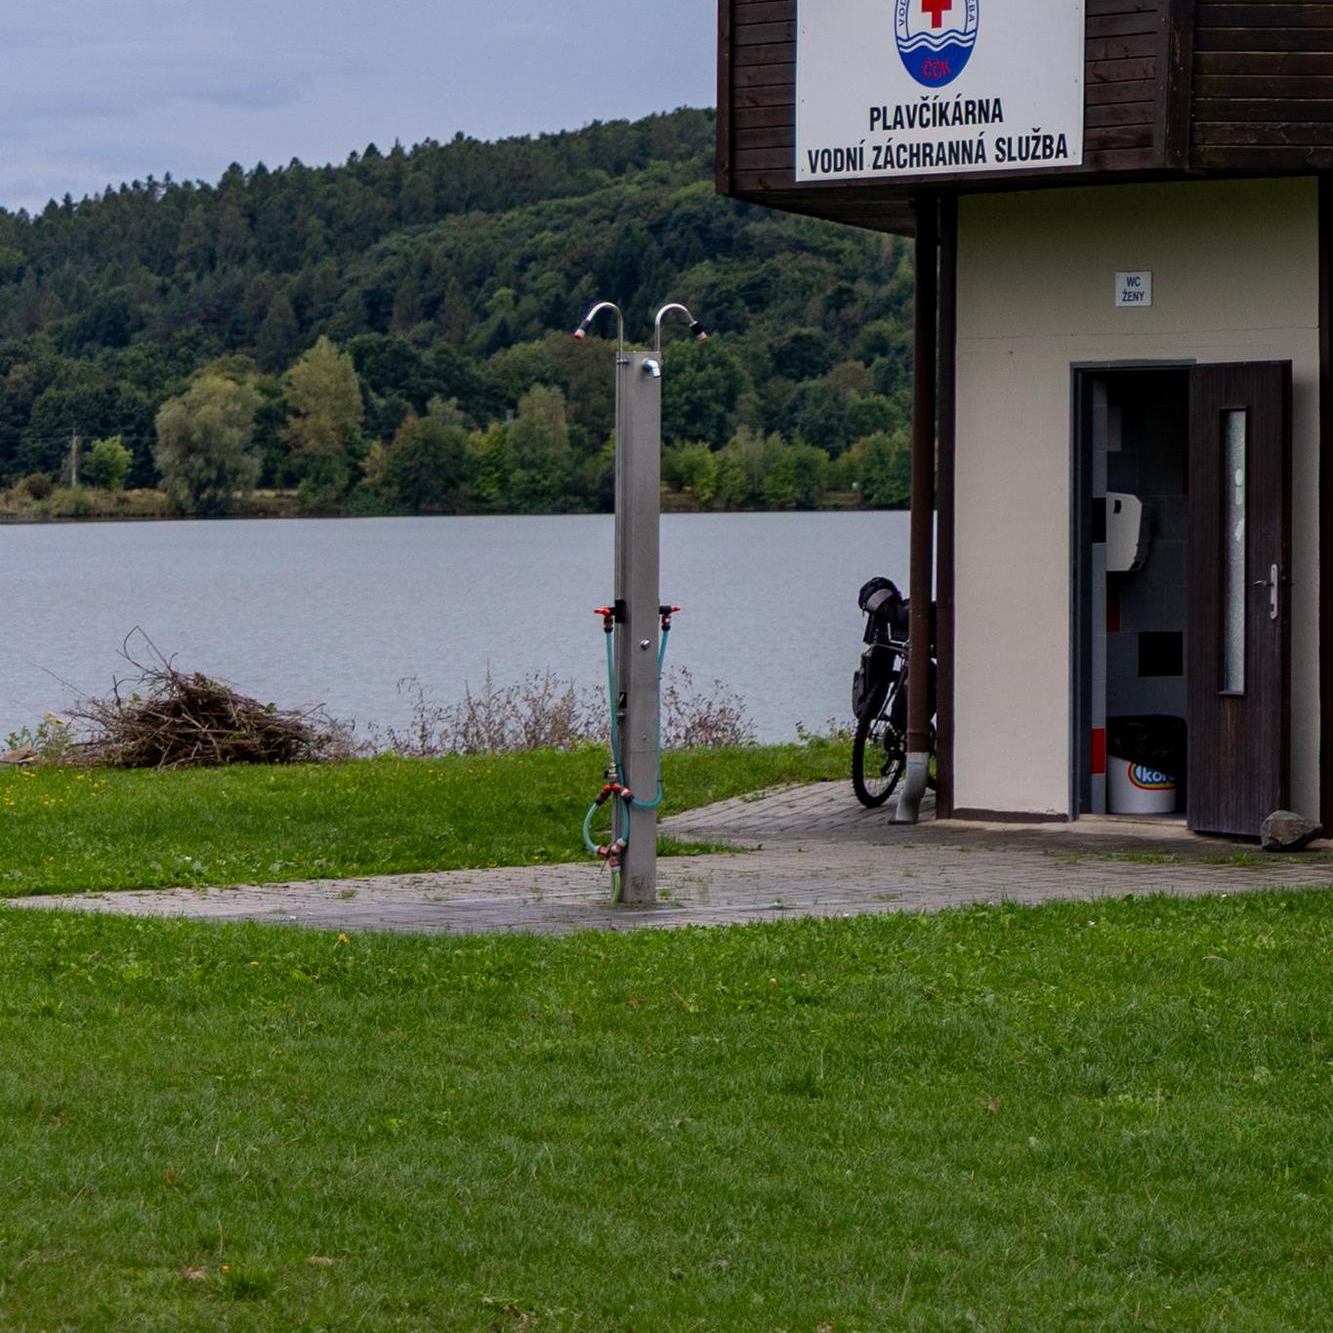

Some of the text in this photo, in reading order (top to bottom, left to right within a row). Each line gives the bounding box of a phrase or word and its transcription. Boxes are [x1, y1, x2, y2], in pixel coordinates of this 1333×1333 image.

[869, 93, 1004, 132] PLAVČÍKÁRNA
[808, 128, 1068, 174] VODNÍ ZÁCHRANNÁ SLUŽBA
[1126, 276, 1141, 287] WC
[1122, 289, 1145, 302] ŽENY
